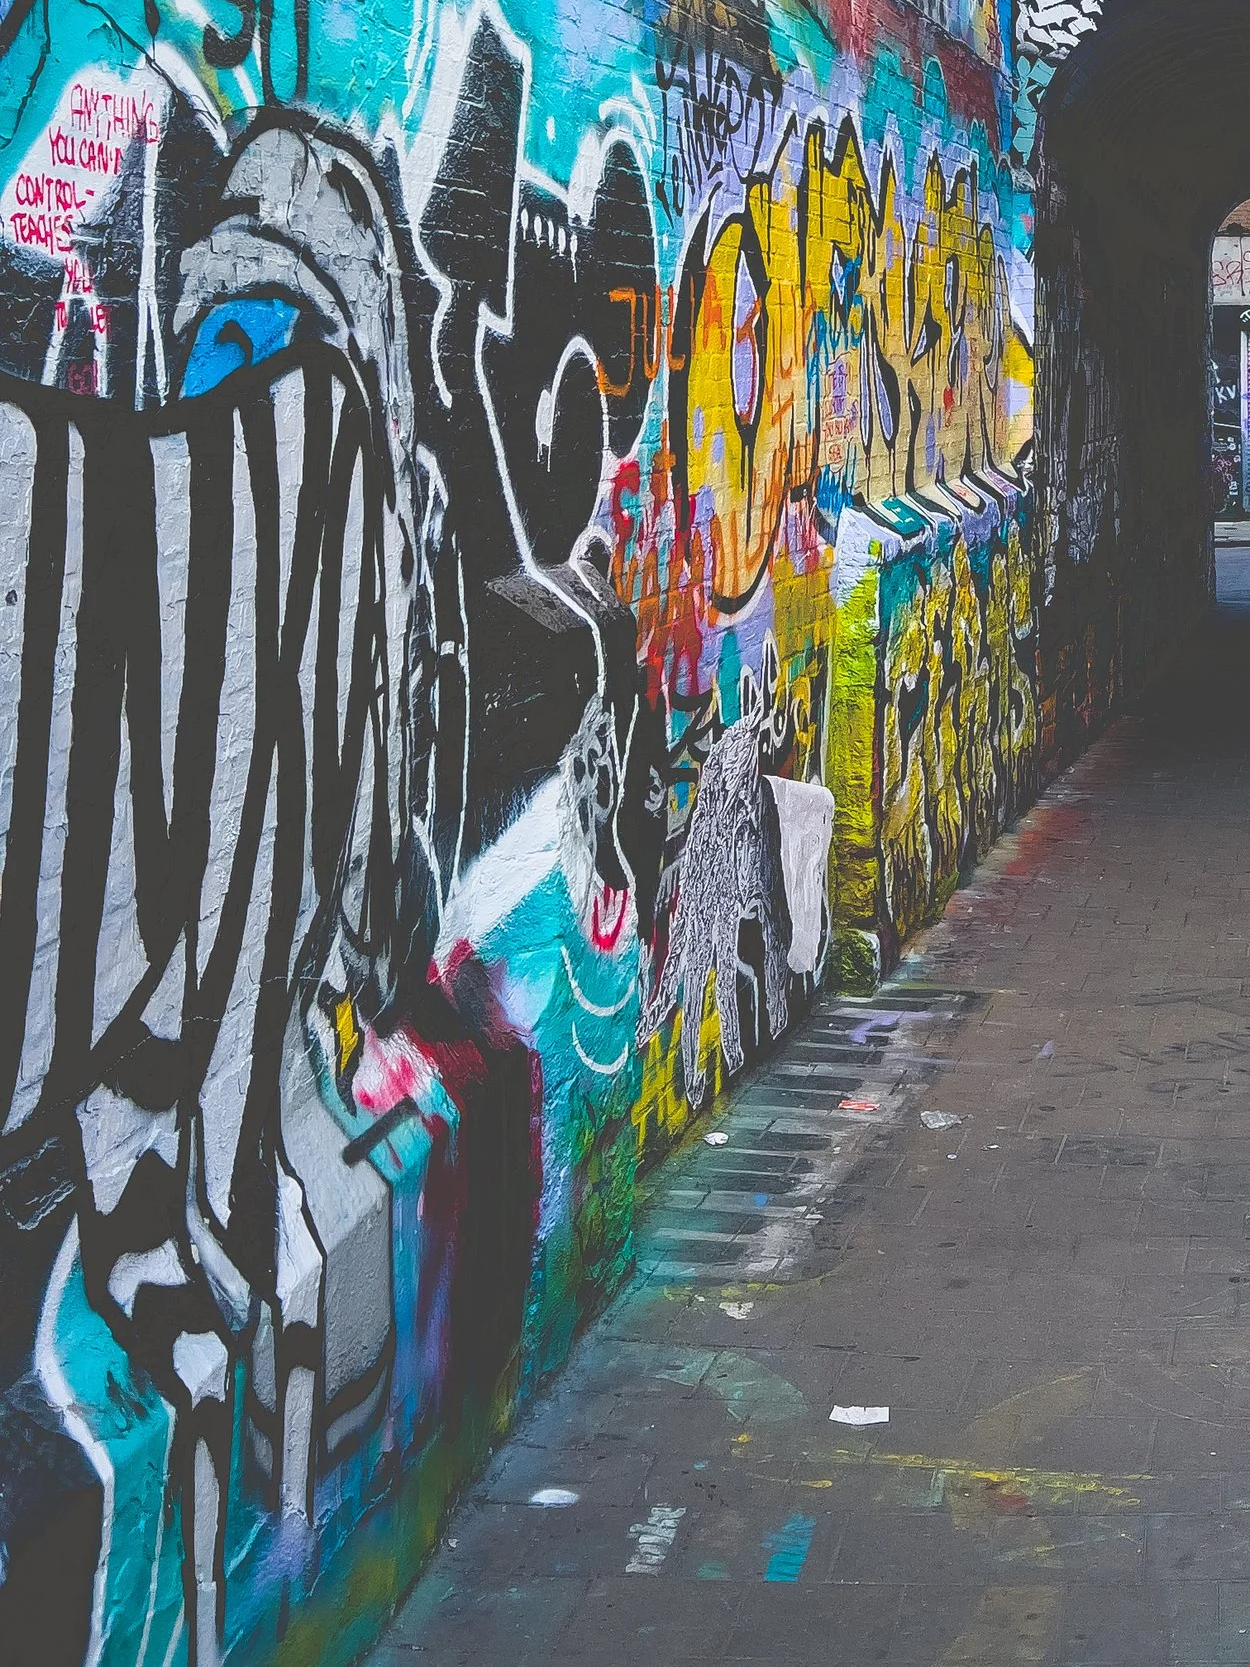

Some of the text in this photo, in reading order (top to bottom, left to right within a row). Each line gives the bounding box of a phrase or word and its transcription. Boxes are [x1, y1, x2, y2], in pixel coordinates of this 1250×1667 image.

[70, 83, 159, 143] ANYTHING
[49, 125, 76, 168] YOU
[10, 212, 75, 254] TEACHES
[64, 258, 93, 295] YOU
